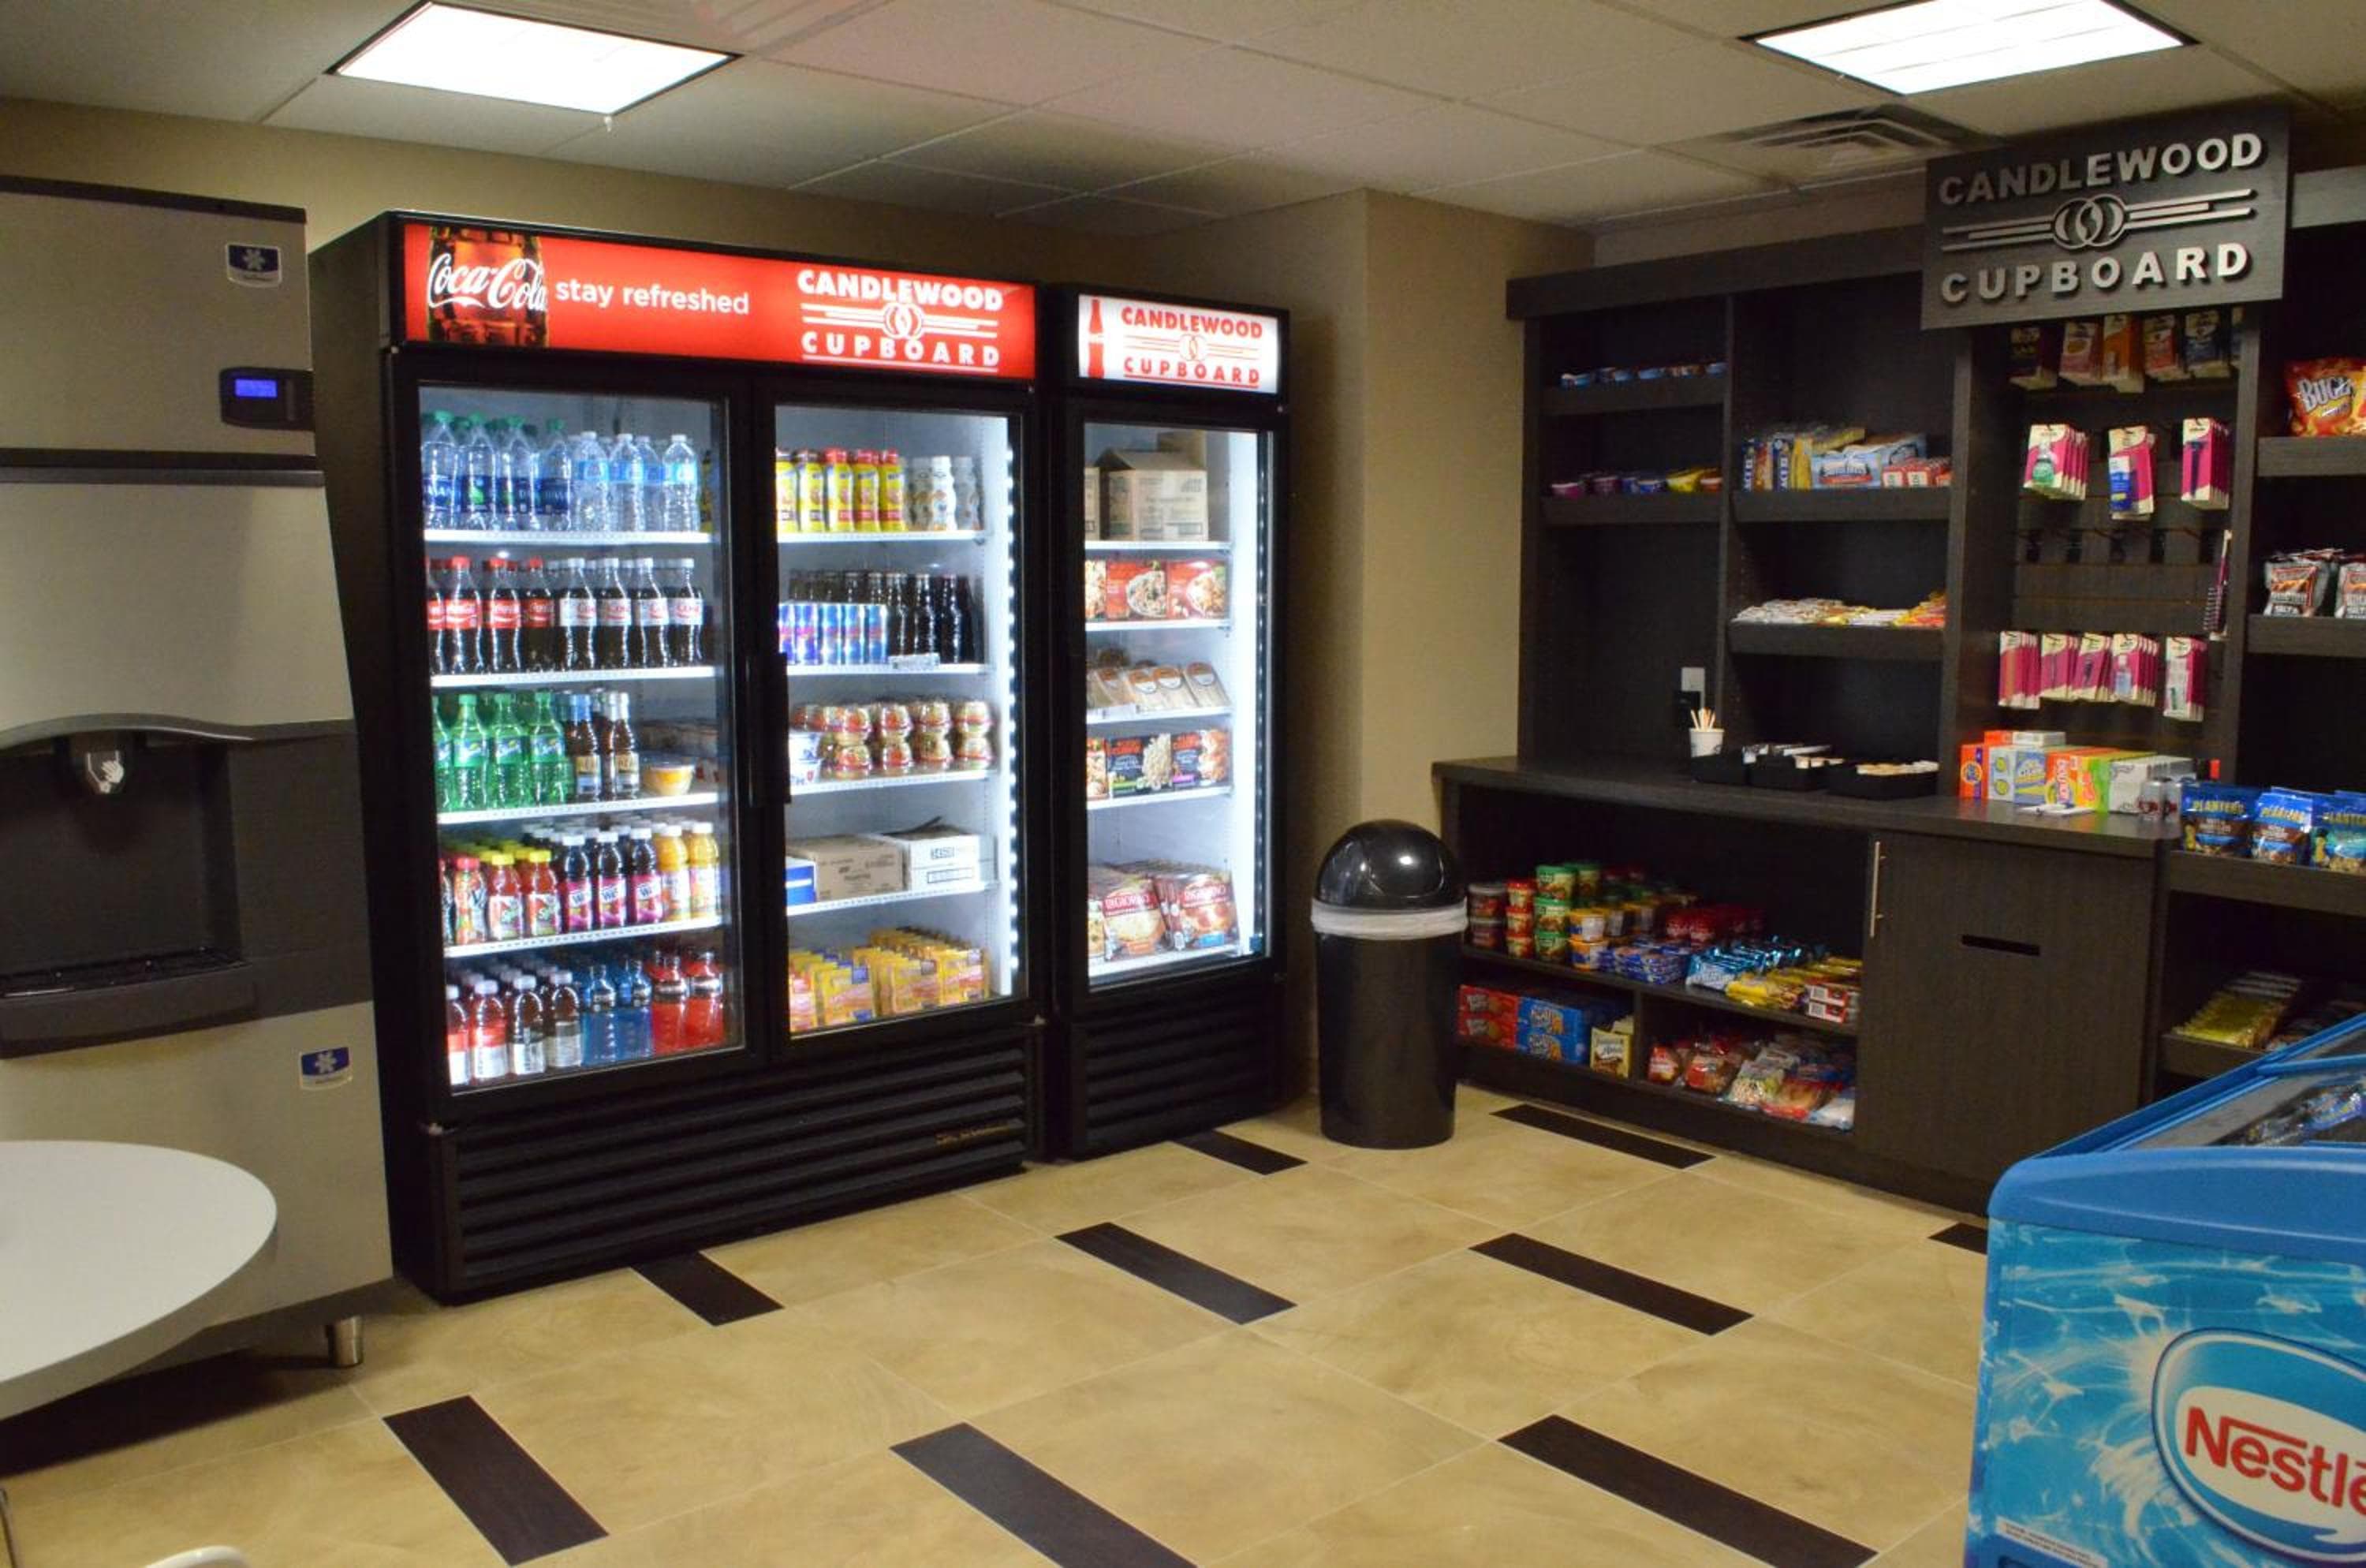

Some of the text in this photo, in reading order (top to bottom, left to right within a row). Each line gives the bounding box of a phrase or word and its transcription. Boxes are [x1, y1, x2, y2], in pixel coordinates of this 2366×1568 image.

[1938, 133, 2263, 205] CANDLEWOOD
[427, 252, 548, 313] Coca-Cola
[797, 269, 1004, 311] CANDLEWOOD
[1941, 241, 2248, 303] CUPBOARD
[555, 278, 751, 317] stay refreshed
[1120, 306, 1263, 338] CANDLEWOOD
[800, 330, 1000, 368] CUPBOARD
[1123, 355, 1260, 384] CUPBOARD
